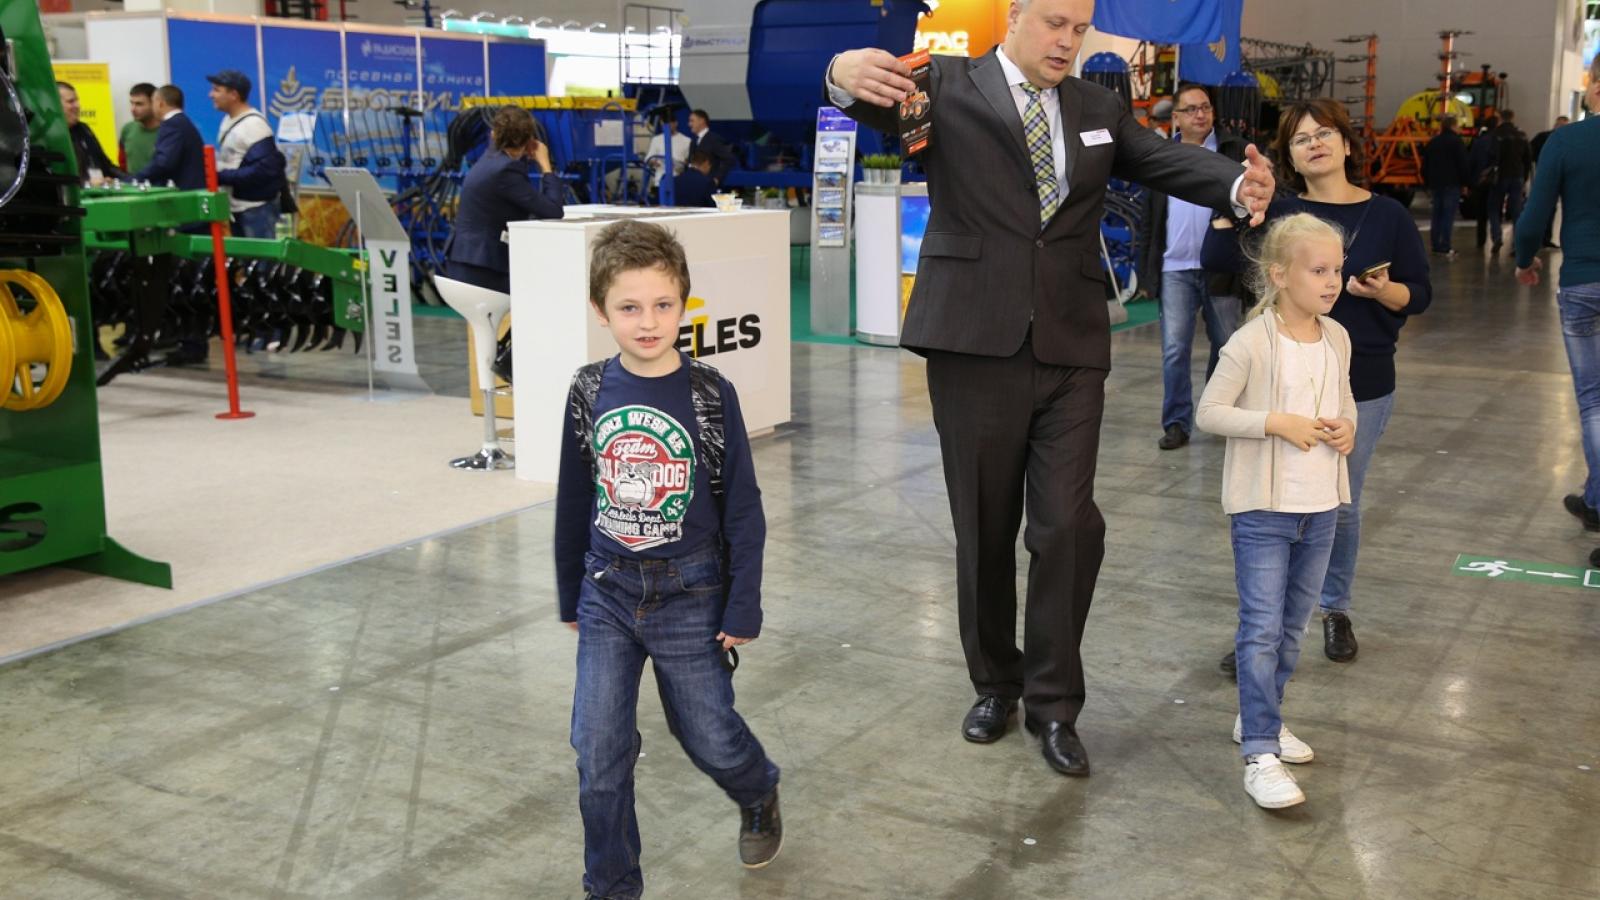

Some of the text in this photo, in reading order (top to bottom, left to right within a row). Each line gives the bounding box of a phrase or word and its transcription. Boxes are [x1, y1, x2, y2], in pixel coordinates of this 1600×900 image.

[420, 74, 484, 86] ехника
[675, 313, 762, 358] ELES
[612, 435, 659, 461] Team
[652, 462, 687, 489] DOG
[643, 522, 678, 537] CAMP
